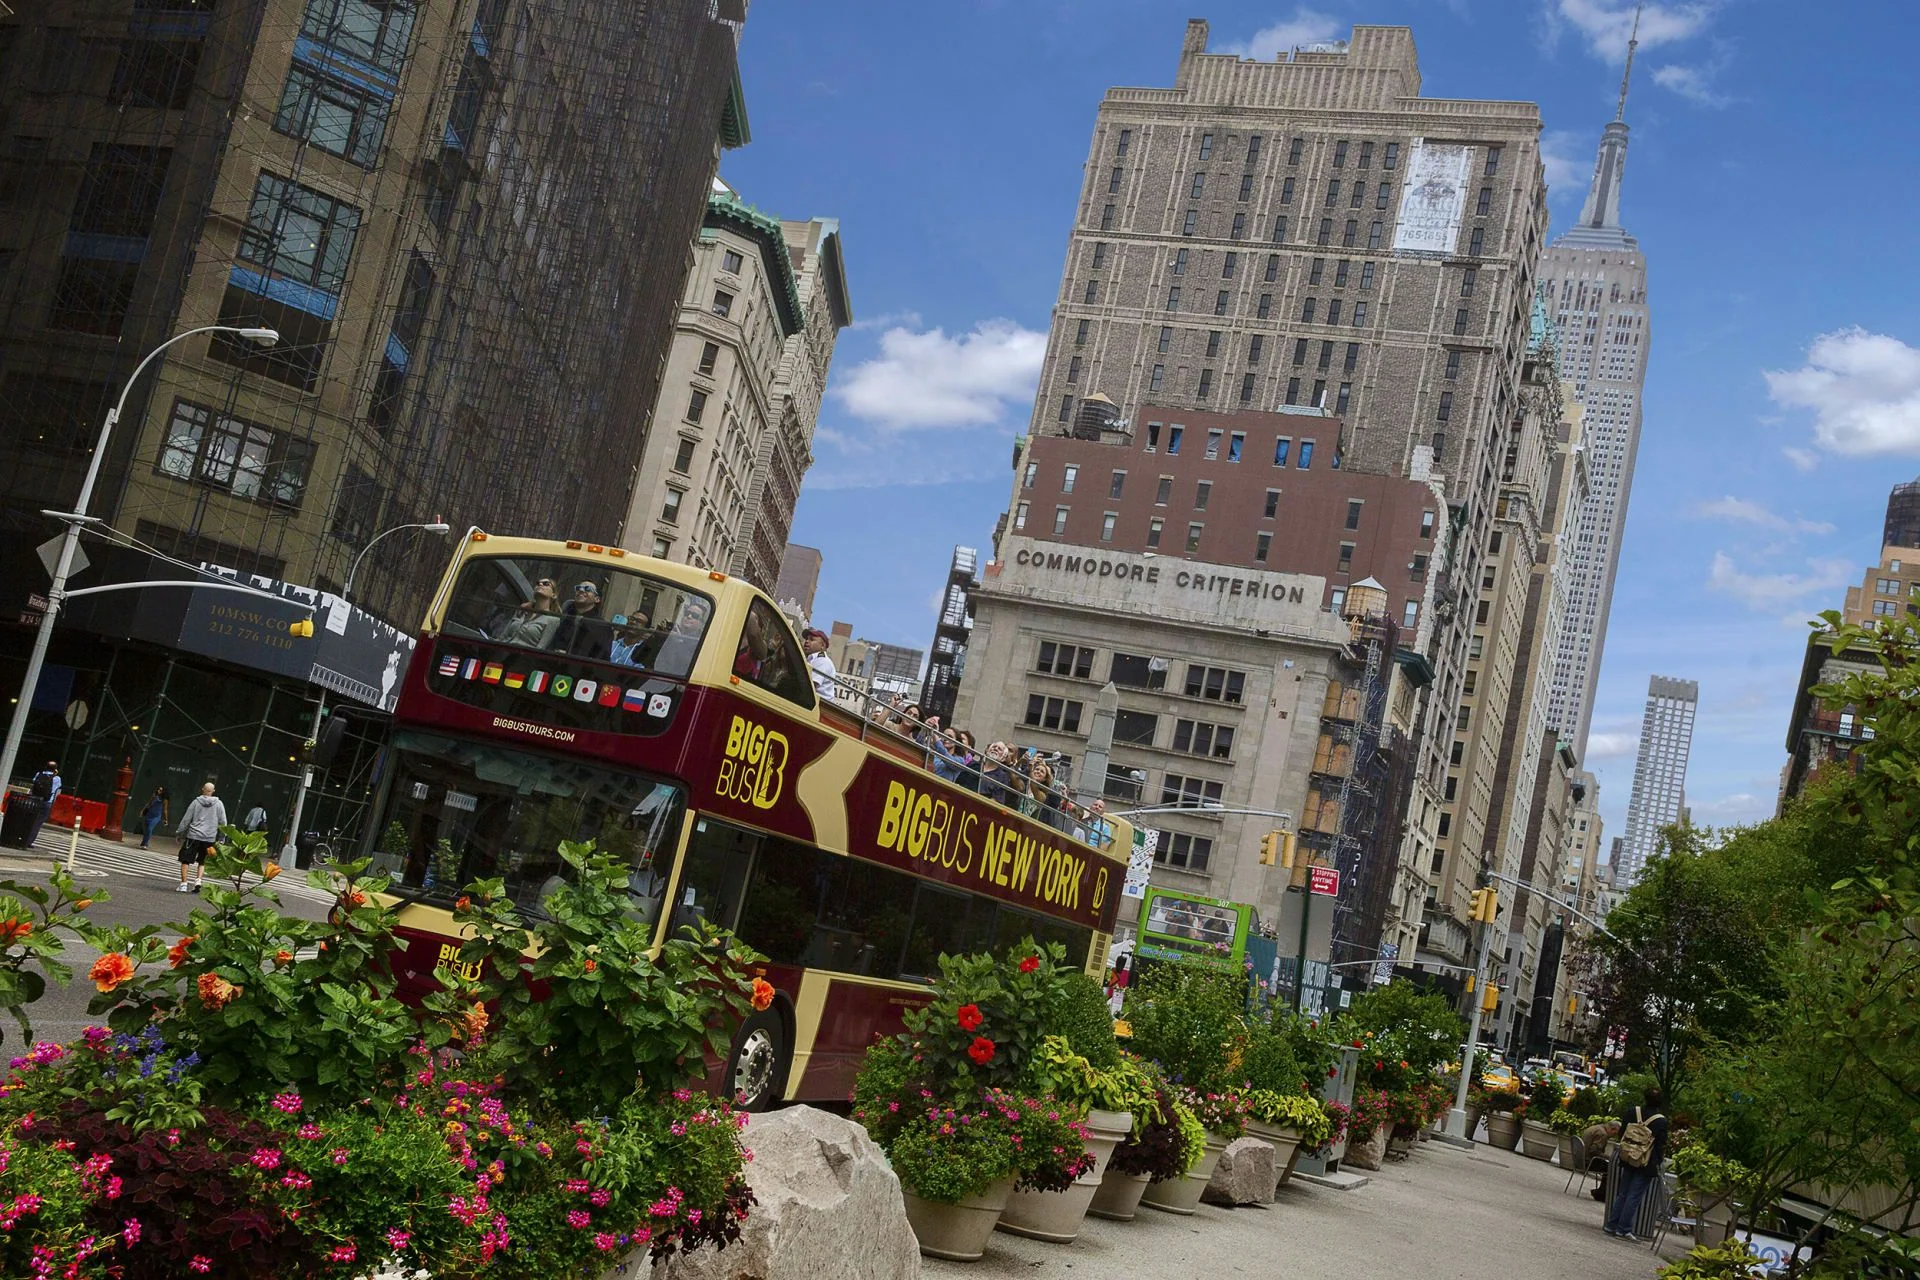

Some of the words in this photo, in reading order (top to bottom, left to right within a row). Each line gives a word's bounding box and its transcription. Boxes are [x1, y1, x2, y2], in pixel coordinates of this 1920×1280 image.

[1016, 549, 1160, 583] COMMODORE
[1176, 571, 1304, 604] CRITERION
[209, 621, 233, 635] 212
[238, 628, 259, 641] 776
[265, 635, 293, 650] 1110
[211, 604, 288, 632] 10MSW.CO
[493, 717, 575, 742] BIGBUSTOURS.COM
[725, 715, 765, 765] BIG
[716, 758, 755, 803] BUS
[979, 821, 1037, 893] NEW
[1034, 843, 1086, 910] YORK
[1316, 869, 1337, 879] STOPPING
